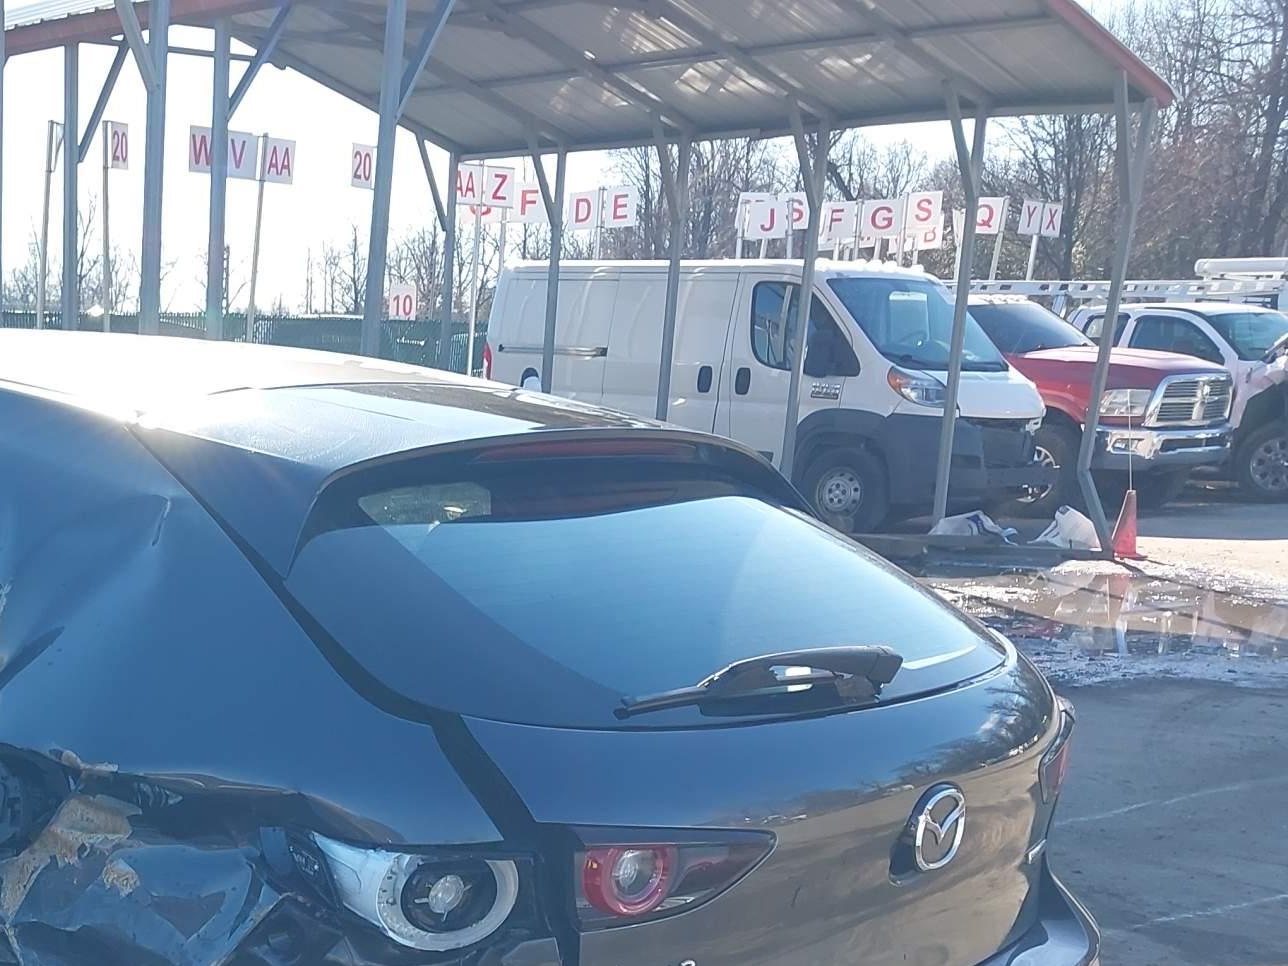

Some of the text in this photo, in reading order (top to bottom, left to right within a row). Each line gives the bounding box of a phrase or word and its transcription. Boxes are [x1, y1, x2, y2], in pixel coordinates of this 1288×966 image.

[112, 130, 128, 162] 20
[191, 133, 212, 166] W
[230, 138, 247, 169] V
[267, 145, 291, 177] AA
[353, 150, 372, 181] 20
[491, 173, 508, 201] Z
[520, 189, 539, 215] F
[575, 198, 591, 223] D
[613, 194, 629, 220] E
[915, 198, 933, 222] S
[760, 208, 775, 232] J
[828, 208, 844, 233] F
[870, 206, 893, 230] G
[976, 204, 994, 228] Q
[1027, 205, 1038, 228] Y
[1046, 208, 1058, 231] X
[392, 294, 413, 316] 10
